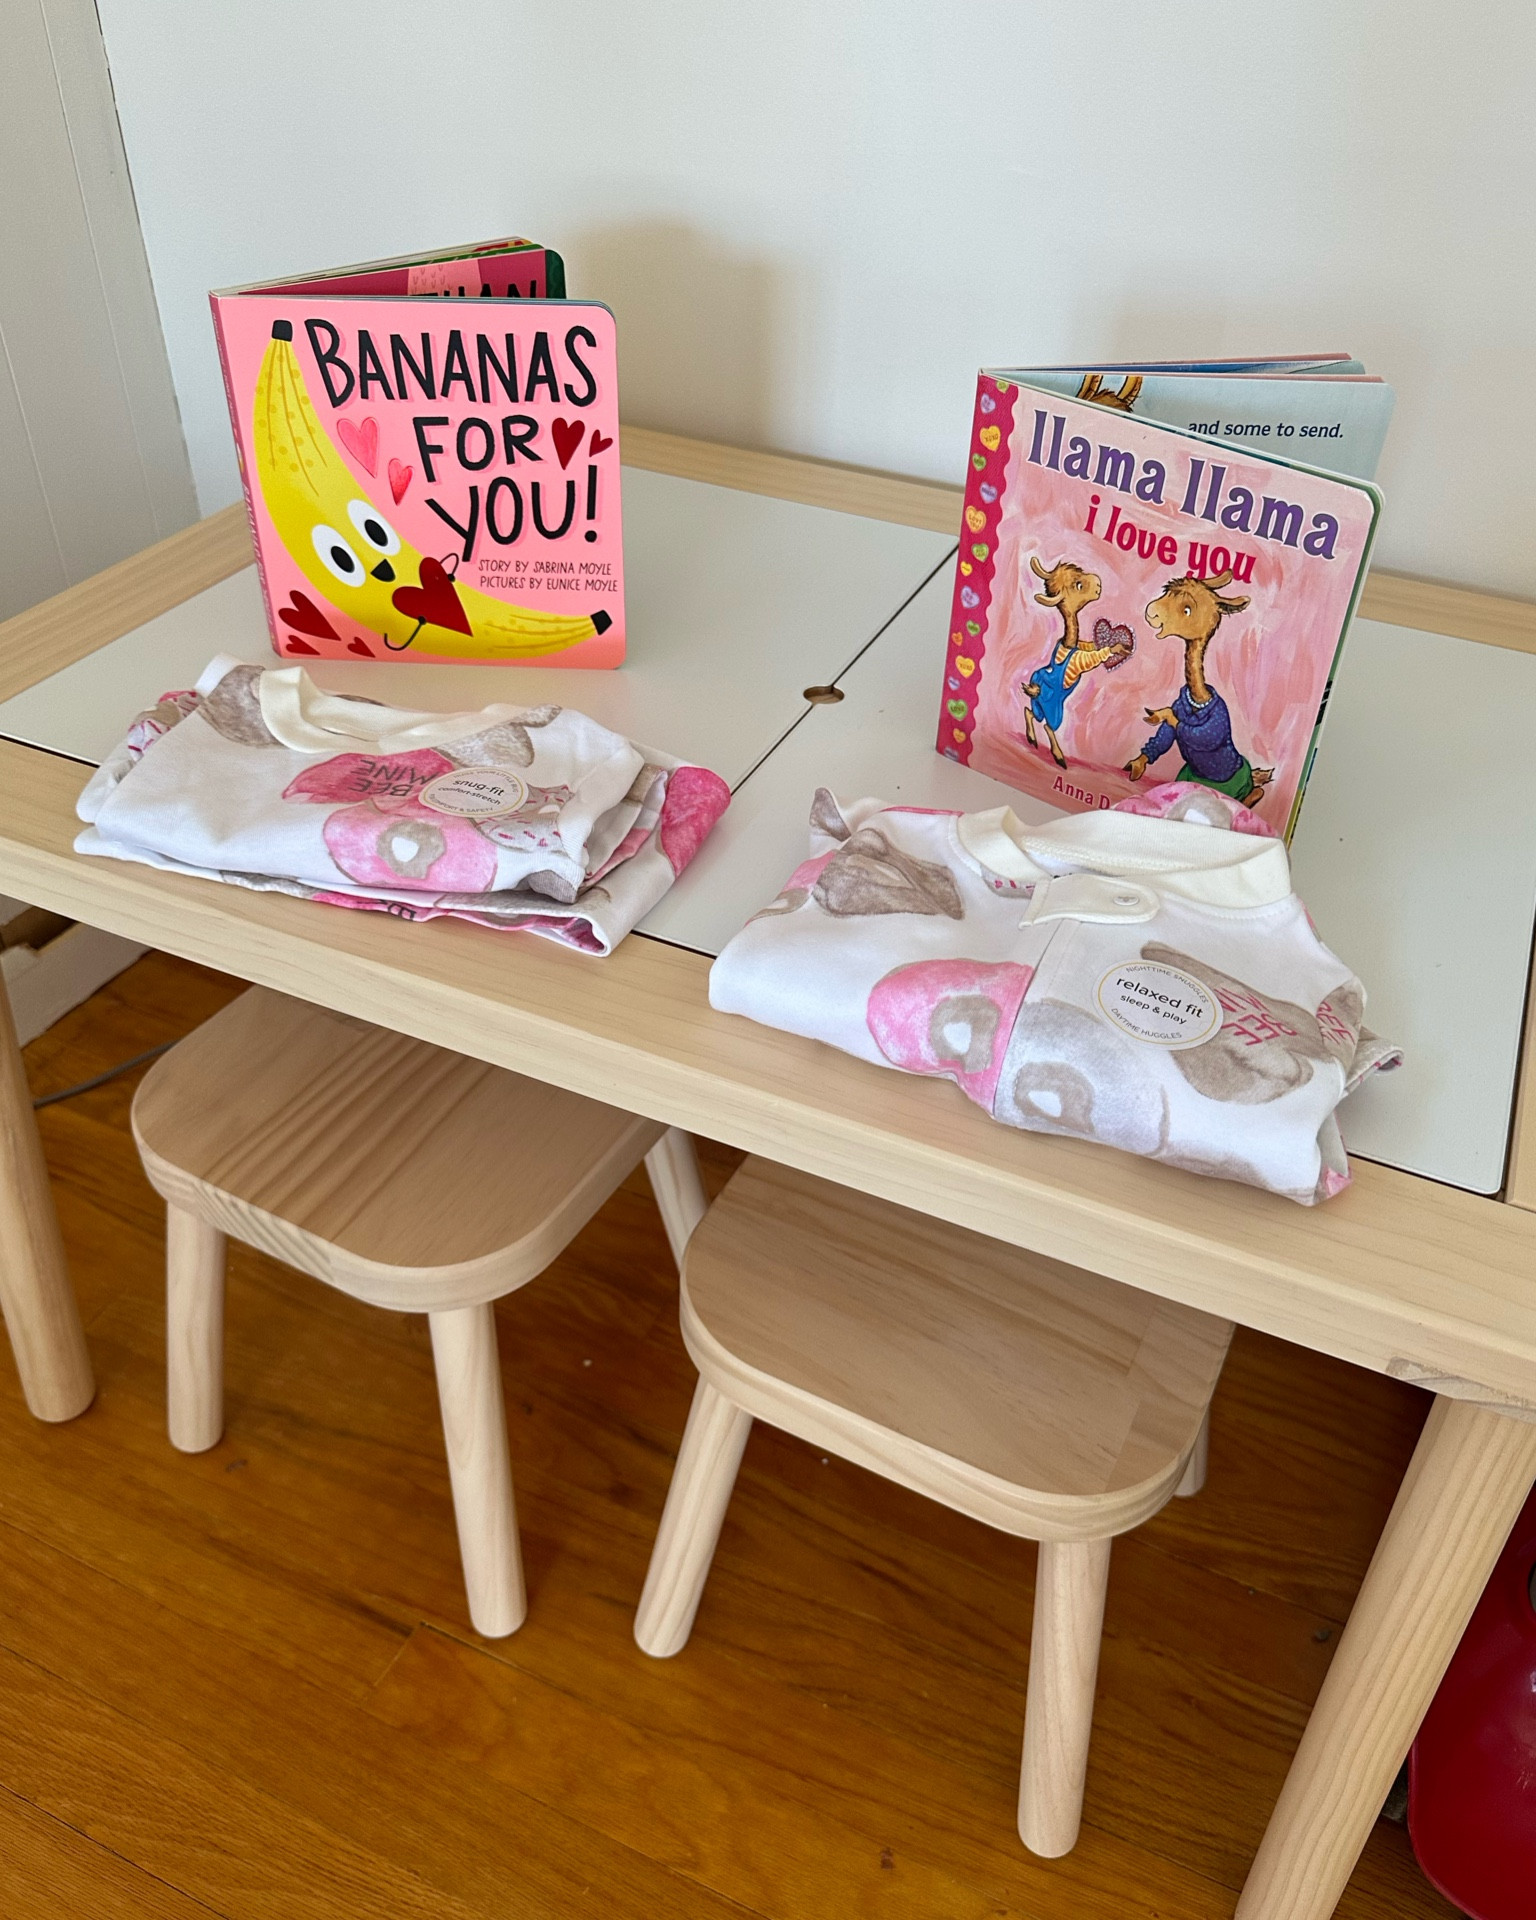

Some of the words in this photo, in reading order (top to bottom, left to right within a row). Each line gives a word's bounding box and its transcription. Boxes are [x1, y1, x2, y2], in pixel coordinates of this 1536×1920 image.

[304, 318, 597, 408] BANANAS
[1188, 420, 1220, 435] and
[1224, 423, 1271, 436] some
[1277, 422, 1294, 437] to
[1299, 423, 1344, 438] send.
[413, 414, 543, 483] FOR
[1027, 409, 1166, 506] llama
[1179, 457, 1340, 560] llama
[424, 464, 597, 562] YOU!
[1083, 494, 1102, 535] i
[1104, 516, 1177, 566] love
[1187, 541, 1257, 584] you
[479, 559, 511, 572] STORY
[515, 560, 529, 573] BY
[533, 562, 575, 574] SABRINA
[578, 562, 611, 576] MOYLE
[480, 576, 526, 589] PICTURES
[529, 577, 543, 590] BY
[547, 578, 581, 591] EUNICE
[584, 579, 618, 592] MOYLE
[347, 777, 415, 798] BEE
[351, 759, 440, 785] MINE
[438, 787, 501, 806] comfort-stretch
[453, 780, 505, 797] snug-fit
[1052, 775, 1094, 805] Anna
[1116, 977, 1182, 1009] relaxed
[1185, 1003, 1204, 1019] fit
[1125, 965, 1172, 977] NIGHTTIME
[1173, 973, 1209, 1004] SNUGGLES
[1111, 1007, 1140, 1033] DAYTIME
[1141, 1028, 1183, 1039] HUGGLES
[1120, 994, 1151, 1010] sleep
[1152, 1006, 1162, 1014] &
[1162, 1010, 1188, 1025] play
